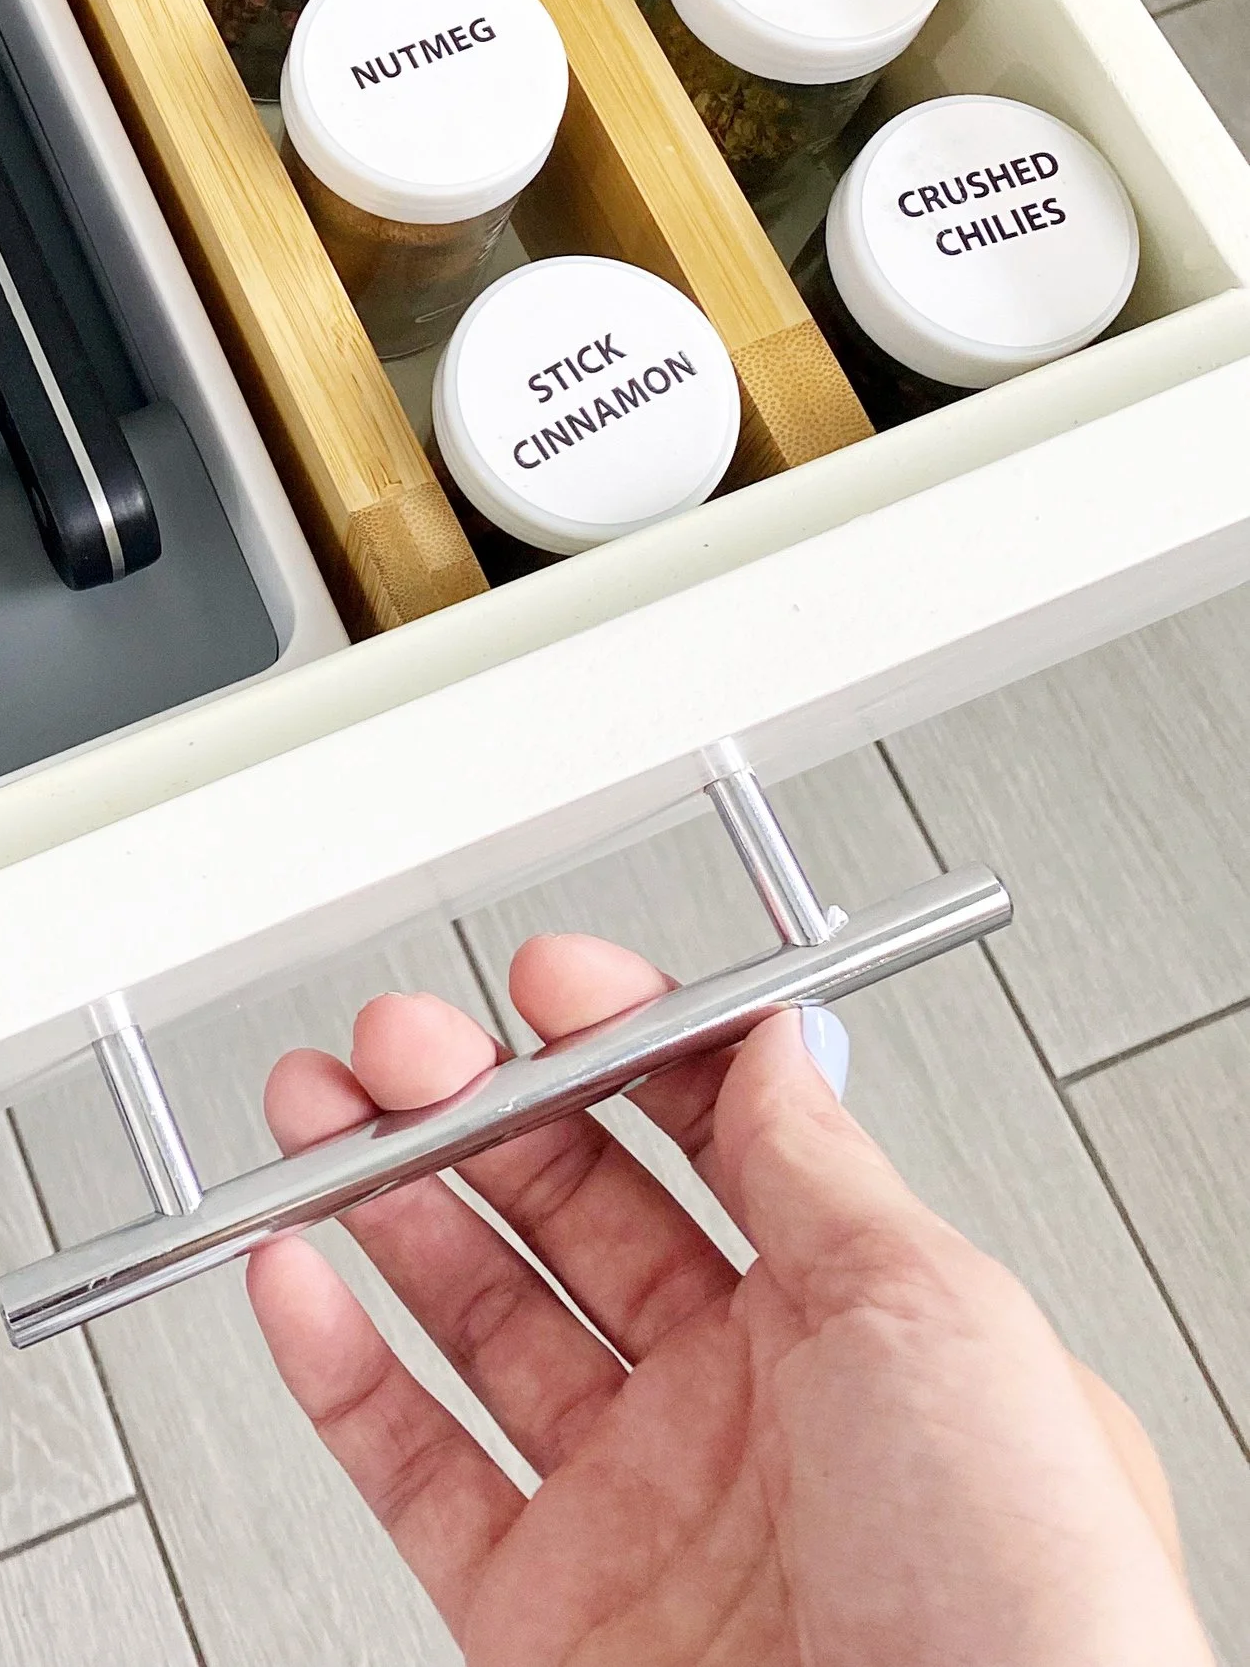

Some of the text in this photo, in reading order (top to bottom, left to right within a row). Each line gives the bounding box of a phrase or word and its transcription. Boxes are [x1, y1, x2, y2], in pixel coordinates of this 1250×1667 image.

[350, 17, 497, 90] NUTMEG
[898, 152, 1059, 218] CRUSHED
[935, 197, 1066, 256] CHILIES
[528, 333, 627, 404] STICK
[513, 351, 697, 470] CINNAMON
